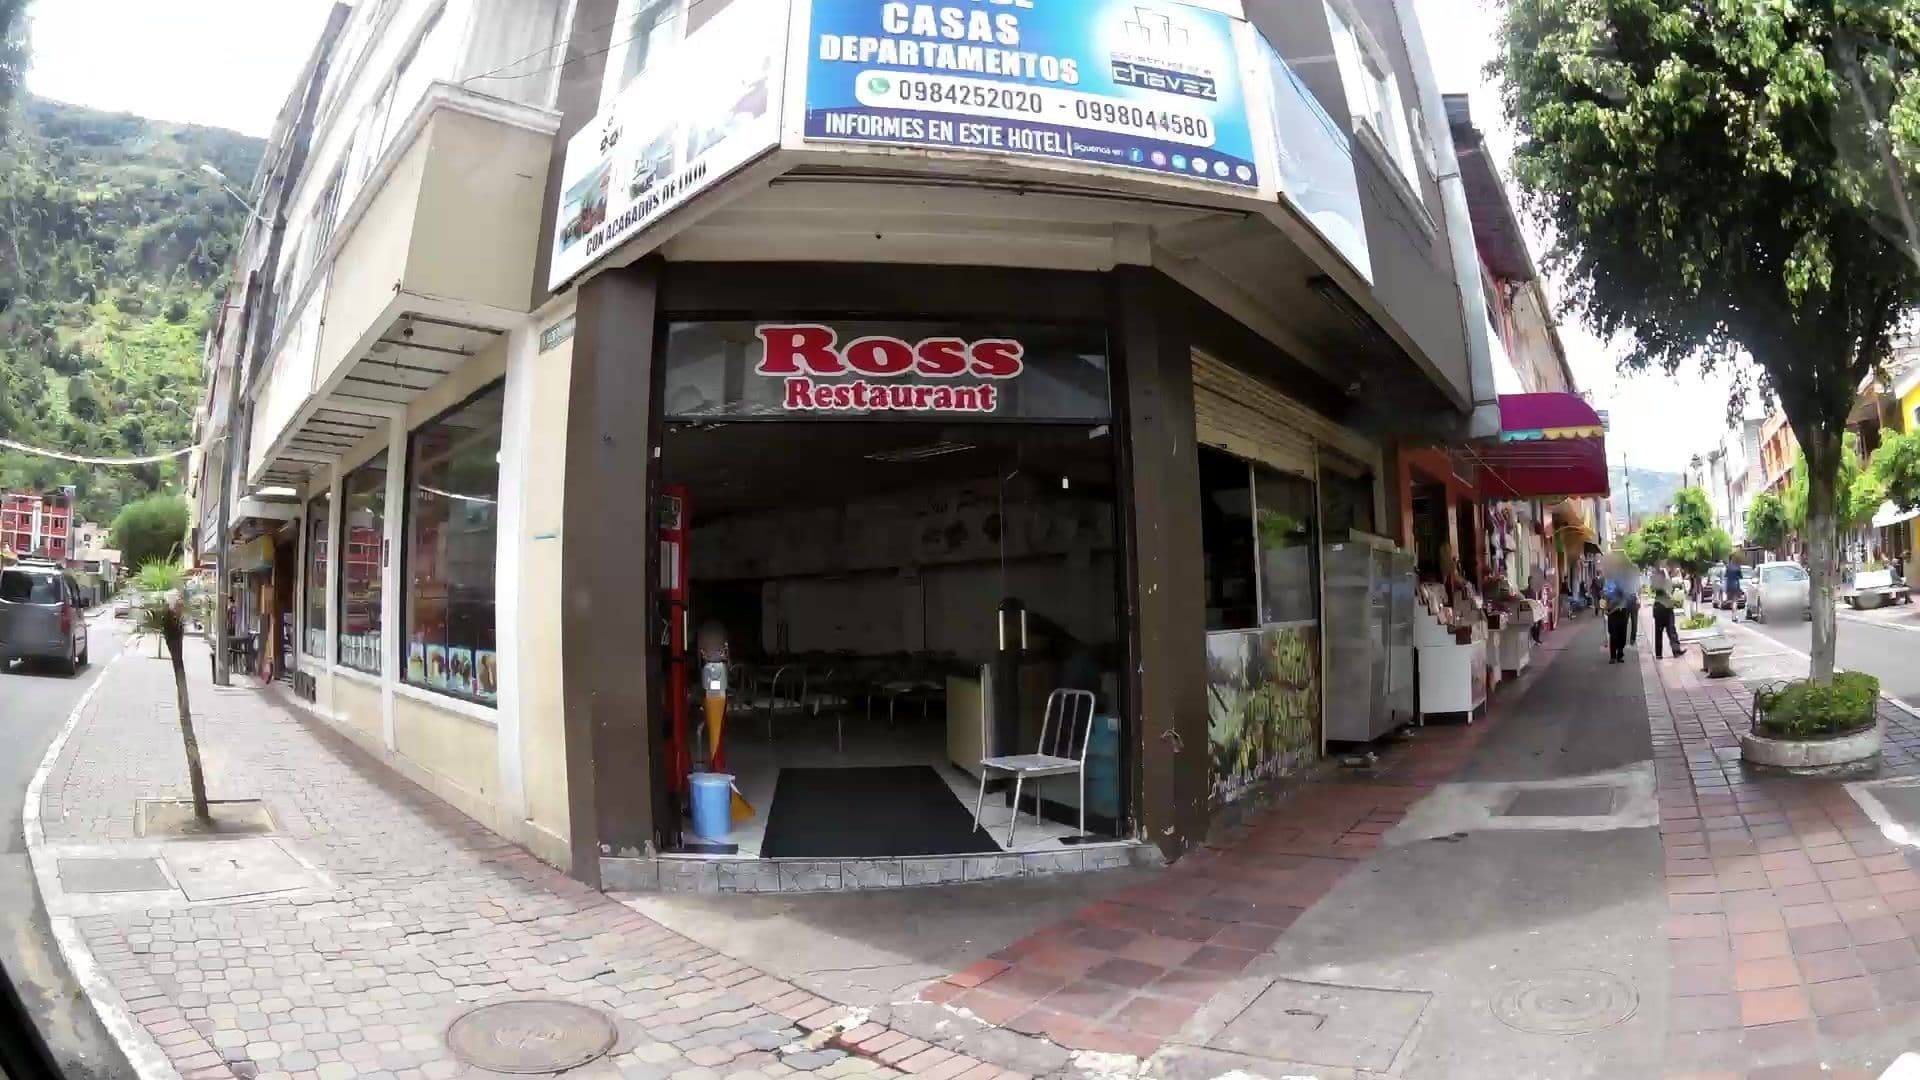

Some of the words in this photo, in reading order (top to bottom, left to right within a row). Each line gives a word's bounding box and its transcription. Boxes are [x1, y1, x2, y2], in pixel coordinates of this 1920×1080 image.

[882, 2, 1020, 46] CASAS
[819, 34, 1079, 84] DEPARTAMENTOS
[899, 79, 1042, 114] 0984252020
[1075, 99, 1208, 139] 0998044580
[825, 112, 925, 139] INFORMES
[928, 119, 953, 143] EN
[959, 122, 1003, 146] ESTE
[1007, 127, 1064, 154] HOTEL
[586, 231, 605, 257] CON
[784, 377, 996, 412] Restaurant
